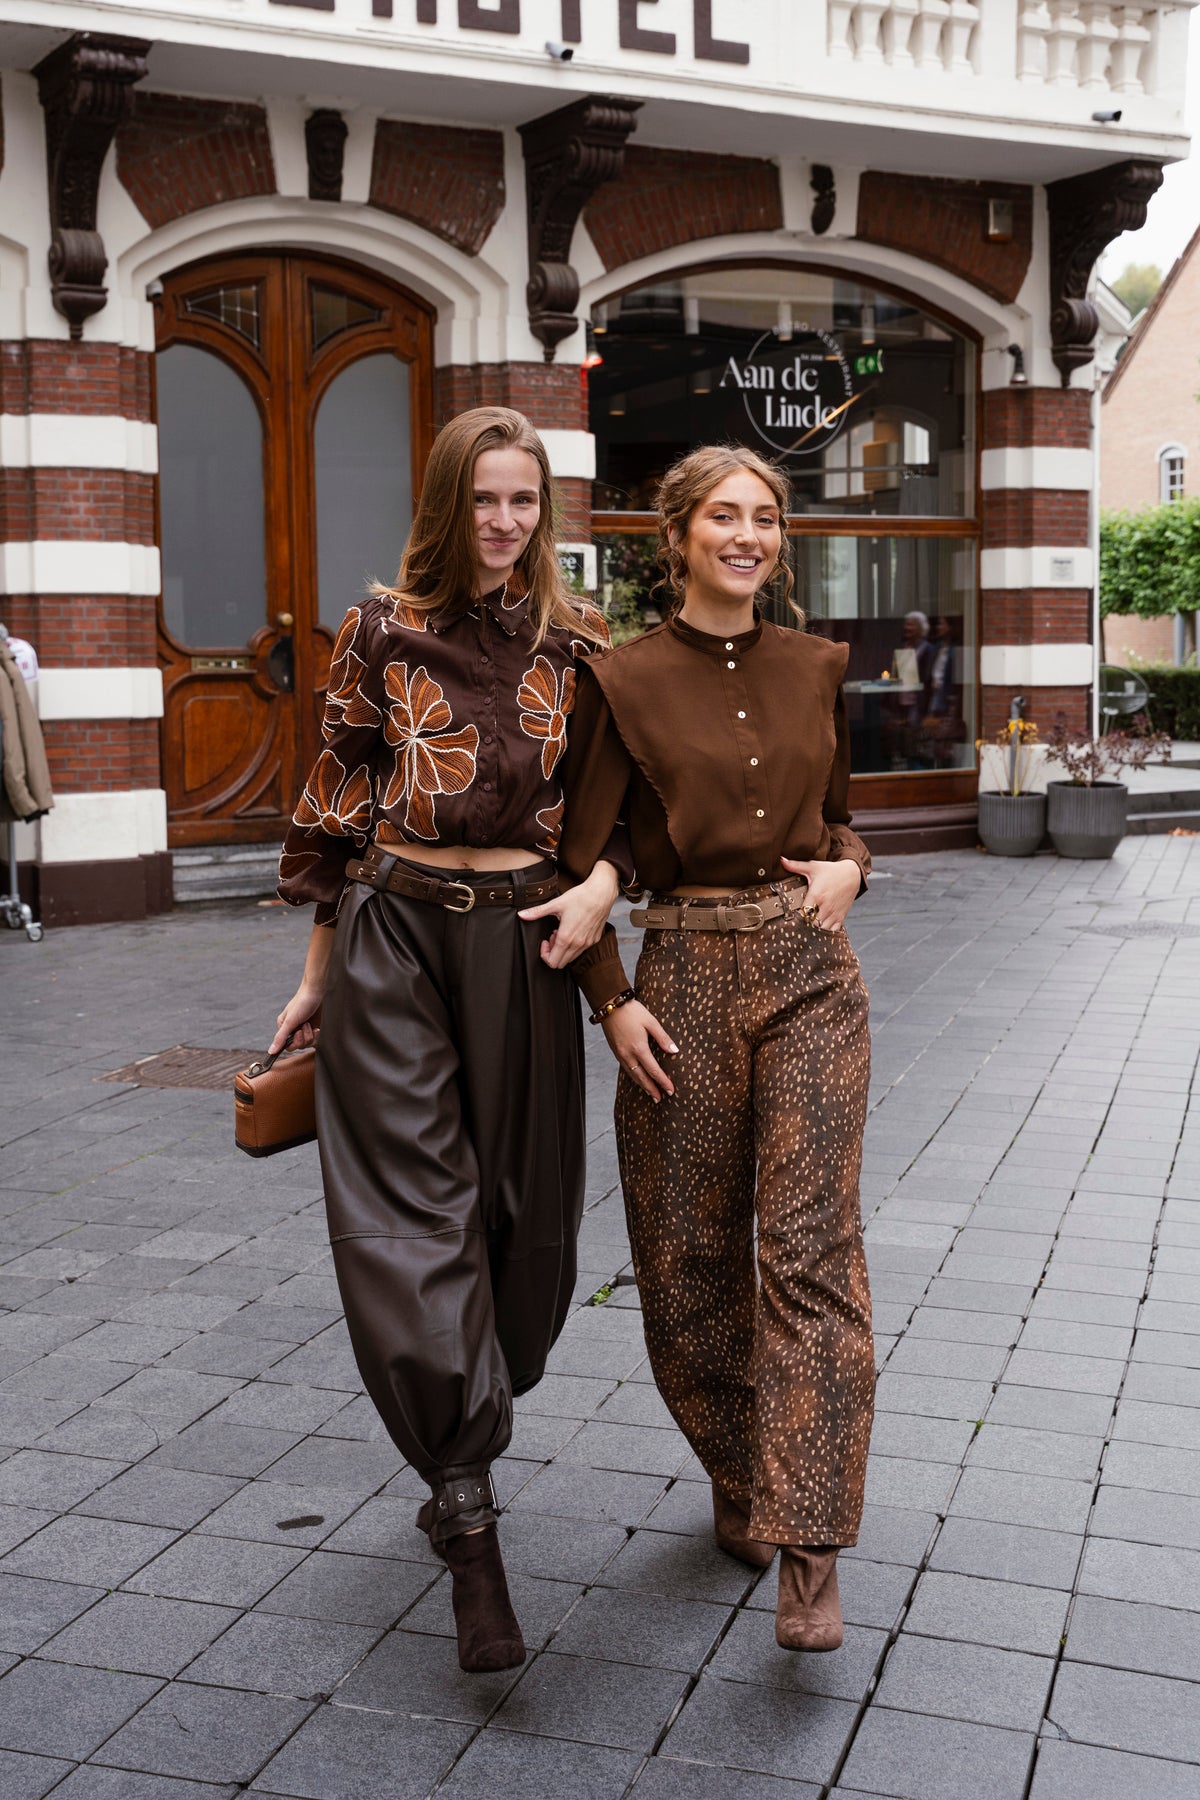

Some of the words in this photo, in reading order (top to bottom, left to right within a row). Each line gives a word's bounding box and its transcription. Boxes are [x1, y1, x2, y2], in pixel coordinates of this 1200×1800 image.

[772, 320, 809, 336] BTRO
[719, 356, 775, 390] Aan
[781, 356, 819, 392] de
[765, 395, 839, 429] Linde
